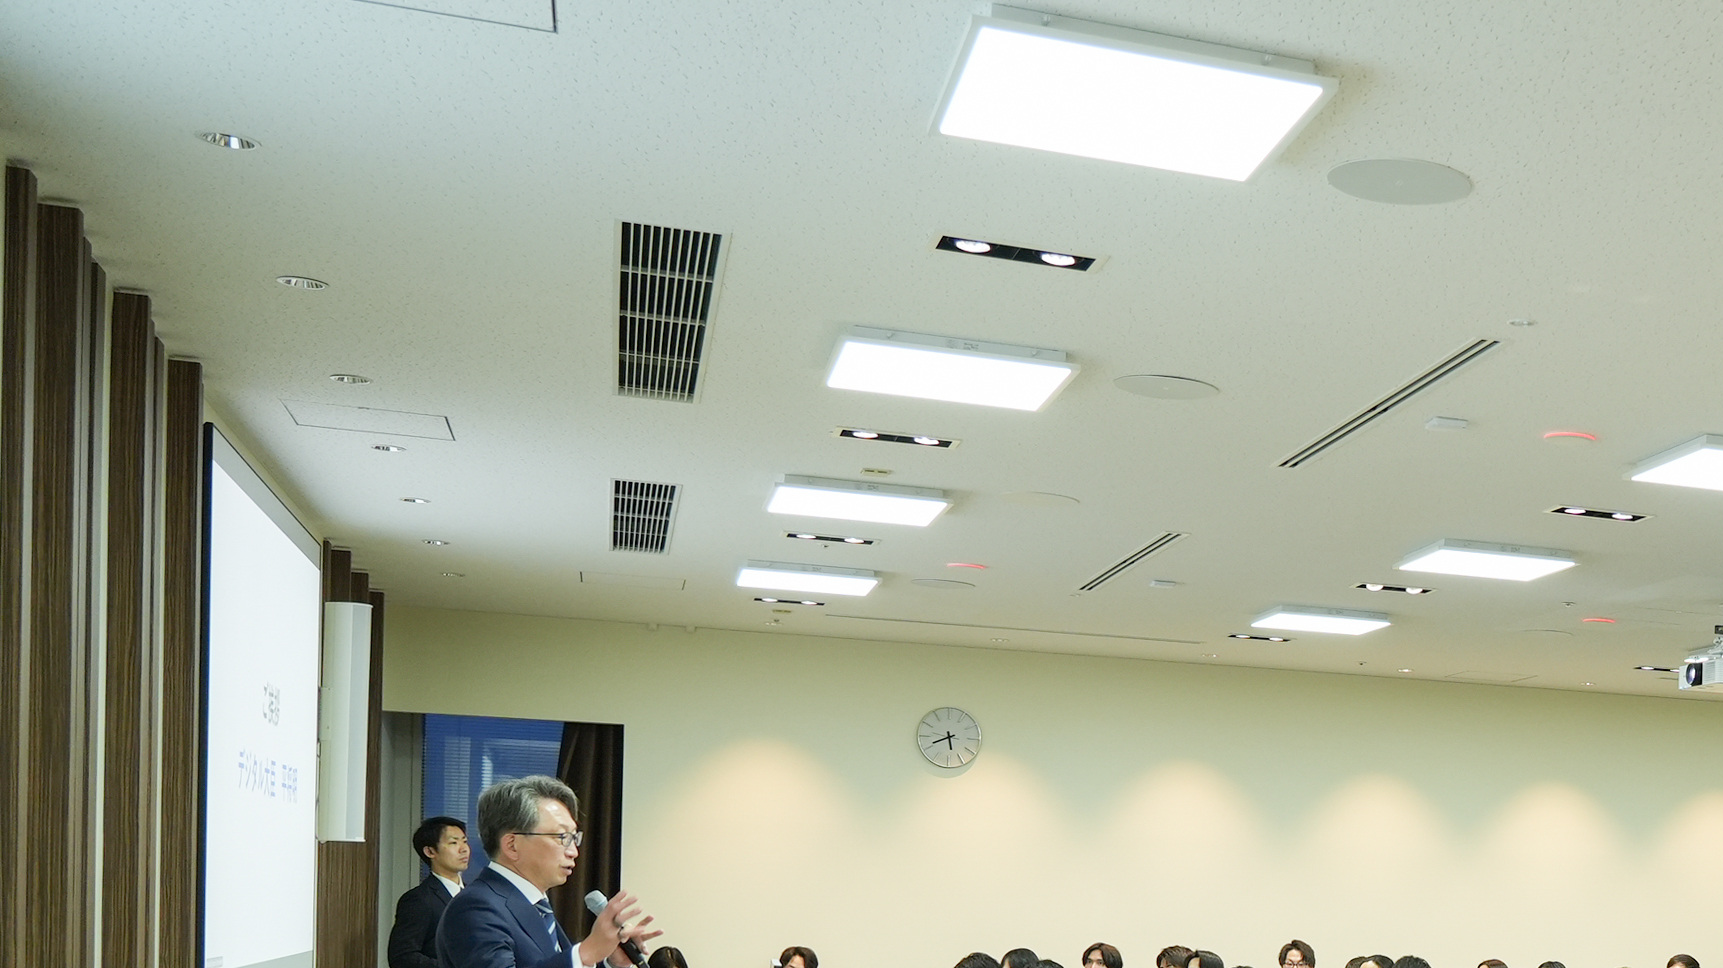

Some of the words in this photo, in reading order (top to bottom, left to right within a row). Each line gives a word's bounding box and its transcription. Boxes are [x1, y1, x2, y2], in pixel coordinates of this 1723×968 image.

[263, 682, 280, 726] ご挨拶
[239, 748, 276, 798] デジタル大臣
